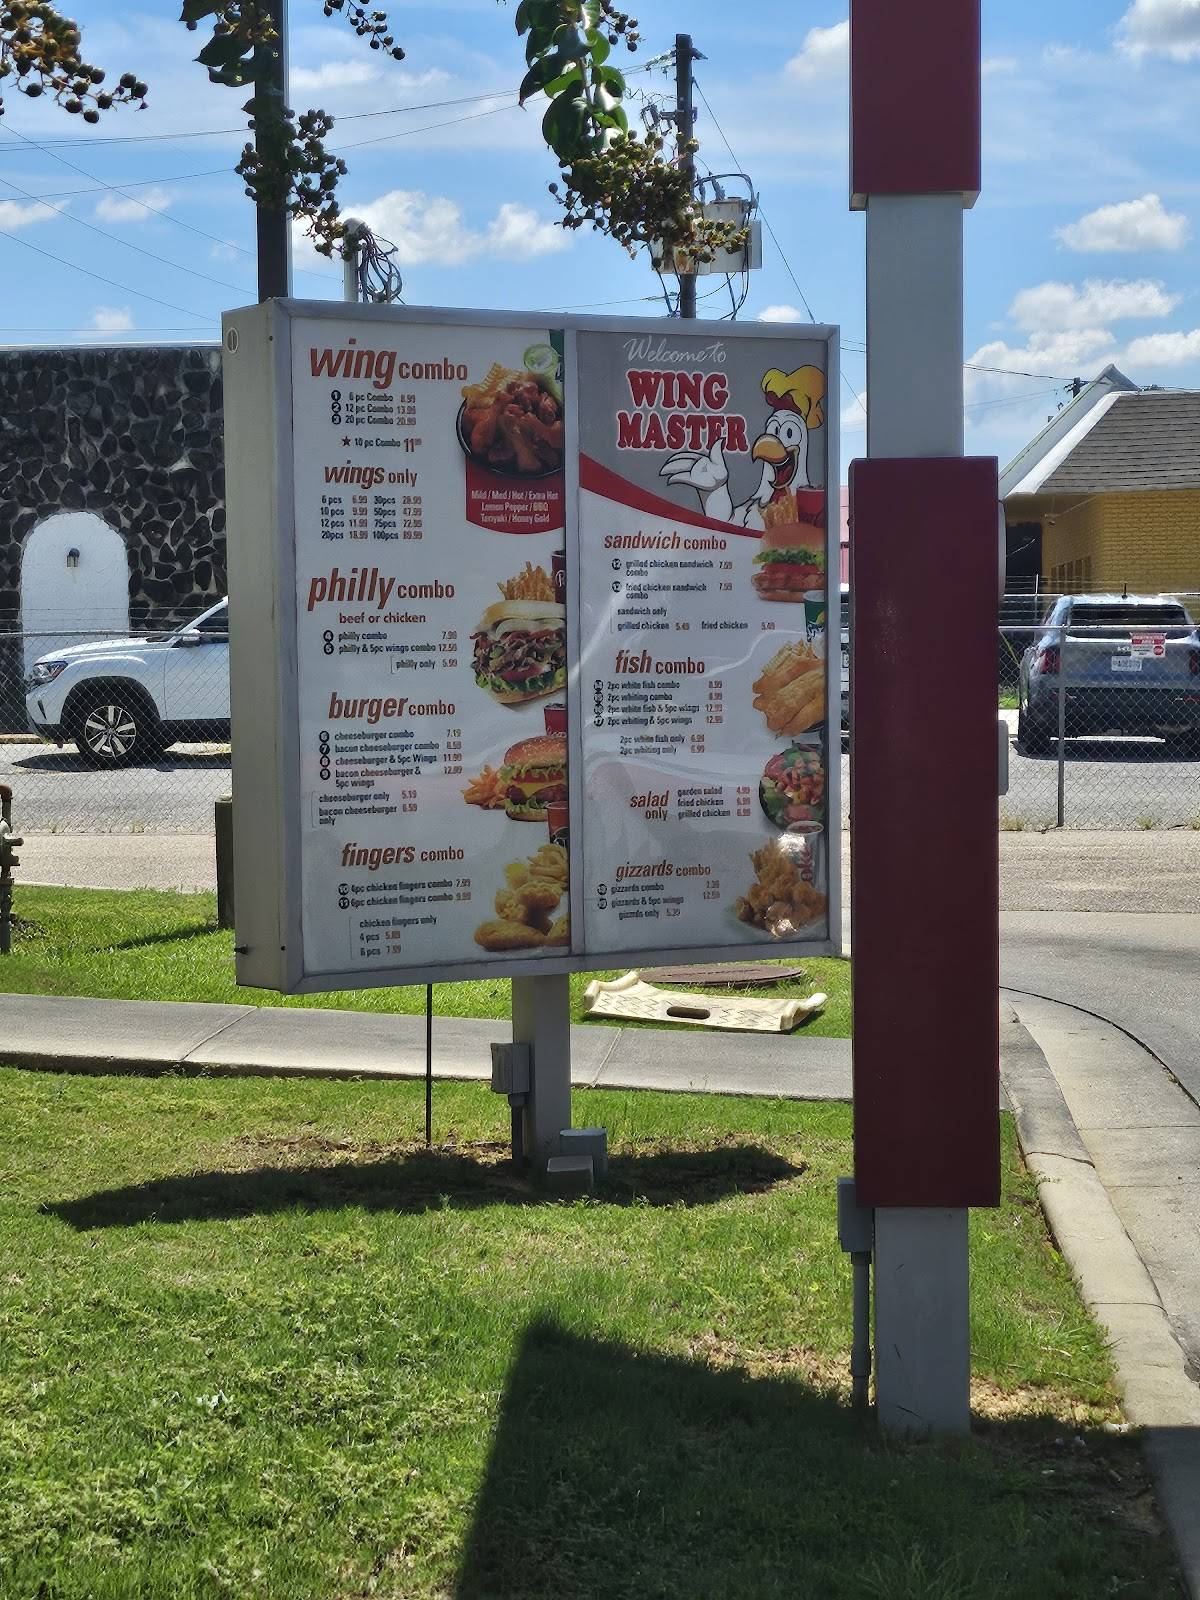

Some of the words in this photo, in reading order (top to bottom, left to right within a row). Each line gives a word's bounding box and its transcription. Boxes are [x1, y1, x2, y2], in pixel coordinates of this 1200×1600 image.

[623, 336, 708, 362] Welcome
[707, 342, 727, 363] to
[311, 338, 397, 389] wing
[399, 357, 467, 380] combo
[626, 369, 730, 411] WING
[367, 393, 393, 401] Combo
[368, 404, 393, 412] Combo
[368, 416, 393, 424] Combo
[617, 410, 748, 452] MASTER
[325, 460, 385, 489] wings
[389, 469, 417, 487] only
[329, 497, 342, 506] pcs
[331, 509, 344, 517] pcs
[331, 521, 344, 529] pcs
[605, 531, 681, 549] sandwich
[684, 536, 727, 550] combo
[650, 560, 678, 568] chicken
[308, 568, 396, 611] philly
[397, 580, 455, 598] combo
[340, 612, 365, 623] beef
[384, 612, 426, 623] chicken
[362, 631, 387, 639] combo
[386, 644, 409, 653] wings
[411, 643, 436, 651] combo
[420, 660, 435, 669] only
[616, 650, 652, 673] fish
[656, 657, 705, 674] combo
[329, 692, 408, 724] burger
[409, 700, 455, 716] combo
[415, 742, 439, 750] combo
[374, 792, 390, 801] only
[630, 790, 669, 808] salad
[645, 807, 668, 821] only
[342, 843, 415, 871] fingers
[421, 846, 464, 861] combo
[616, 860, 674, 882] gizzards
[676, 864, 711, 876] combo
[367, 882, 397, 892] chicken
[367, 895, 398, 905] chicken
[360, 917, 390, 928] chicken
